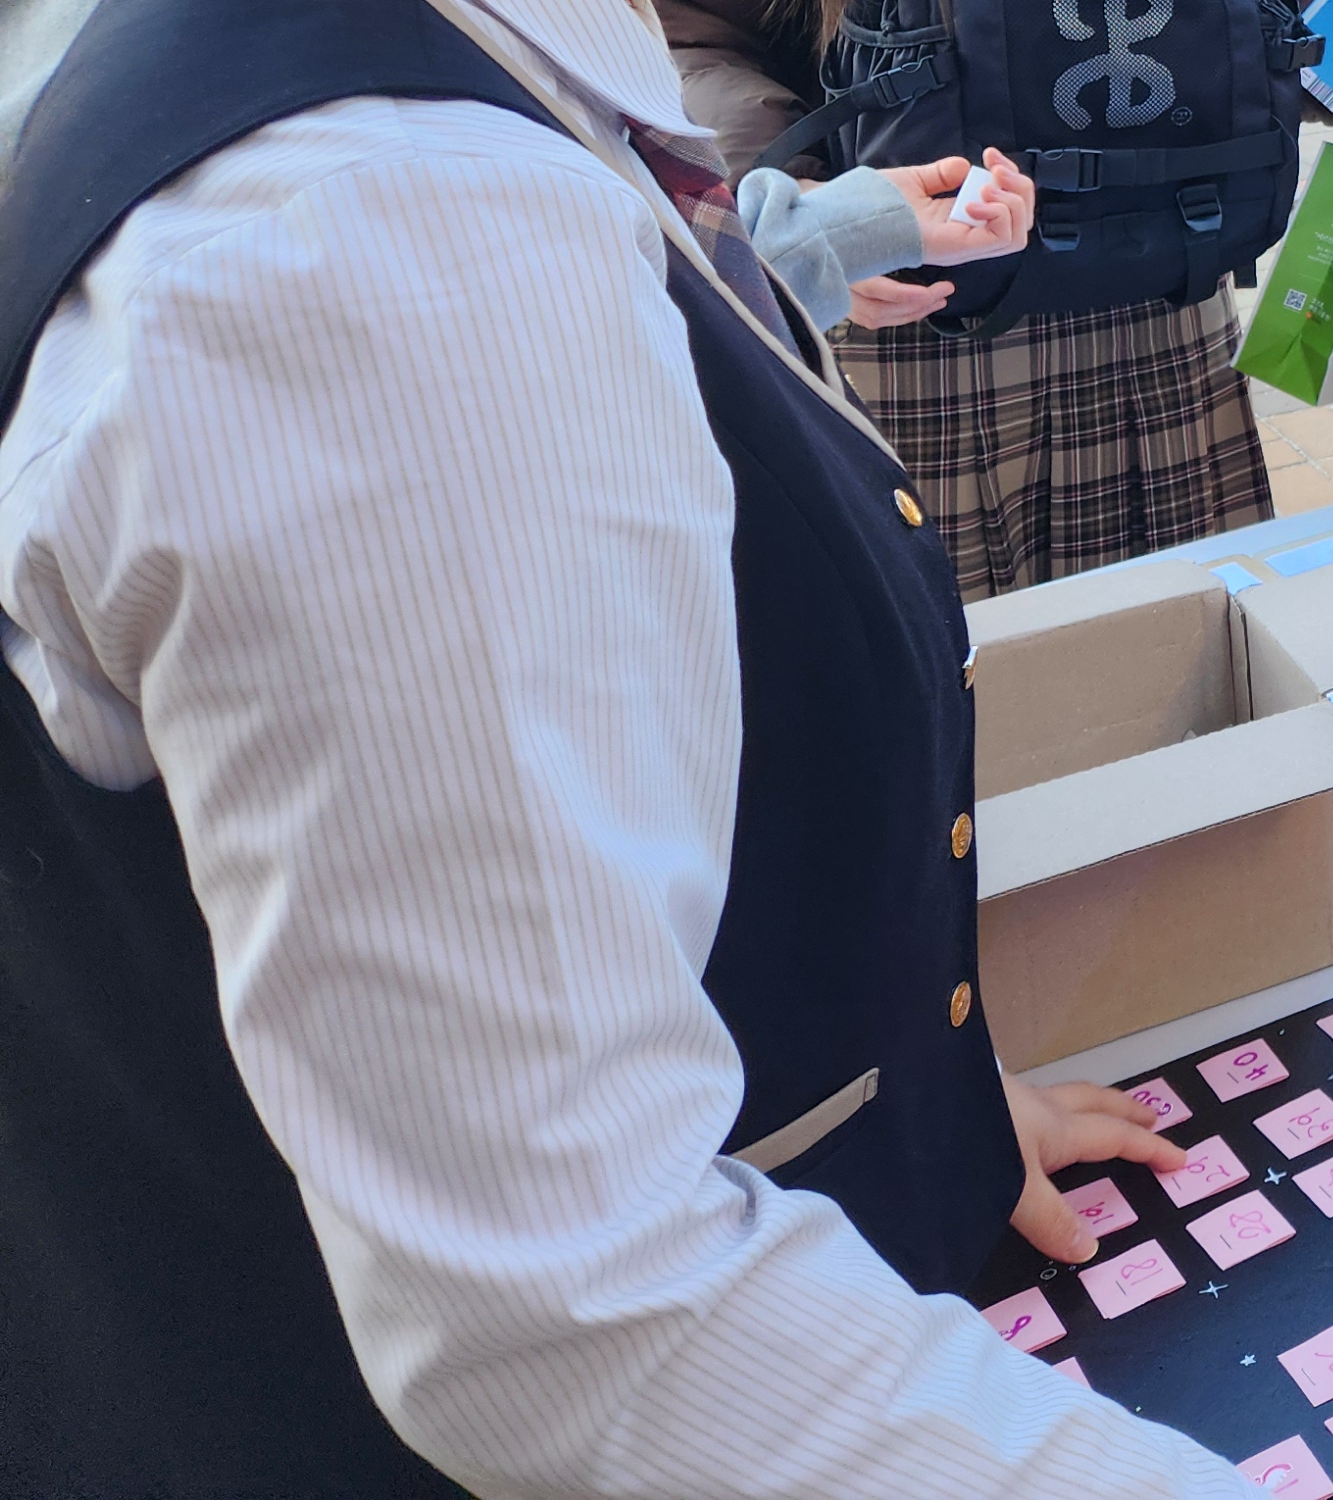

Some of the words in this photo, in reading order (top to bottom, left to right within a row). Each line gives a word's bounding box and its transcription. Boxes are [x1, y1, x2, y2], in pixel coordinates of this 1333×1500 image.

[1233, 1052, 1268, 1081] 40
[1078, 1202, 1114, 1225] 19
[1228, 1210, 1271, 1239] 28
[1121, 1258, 1163, 1285] 18
